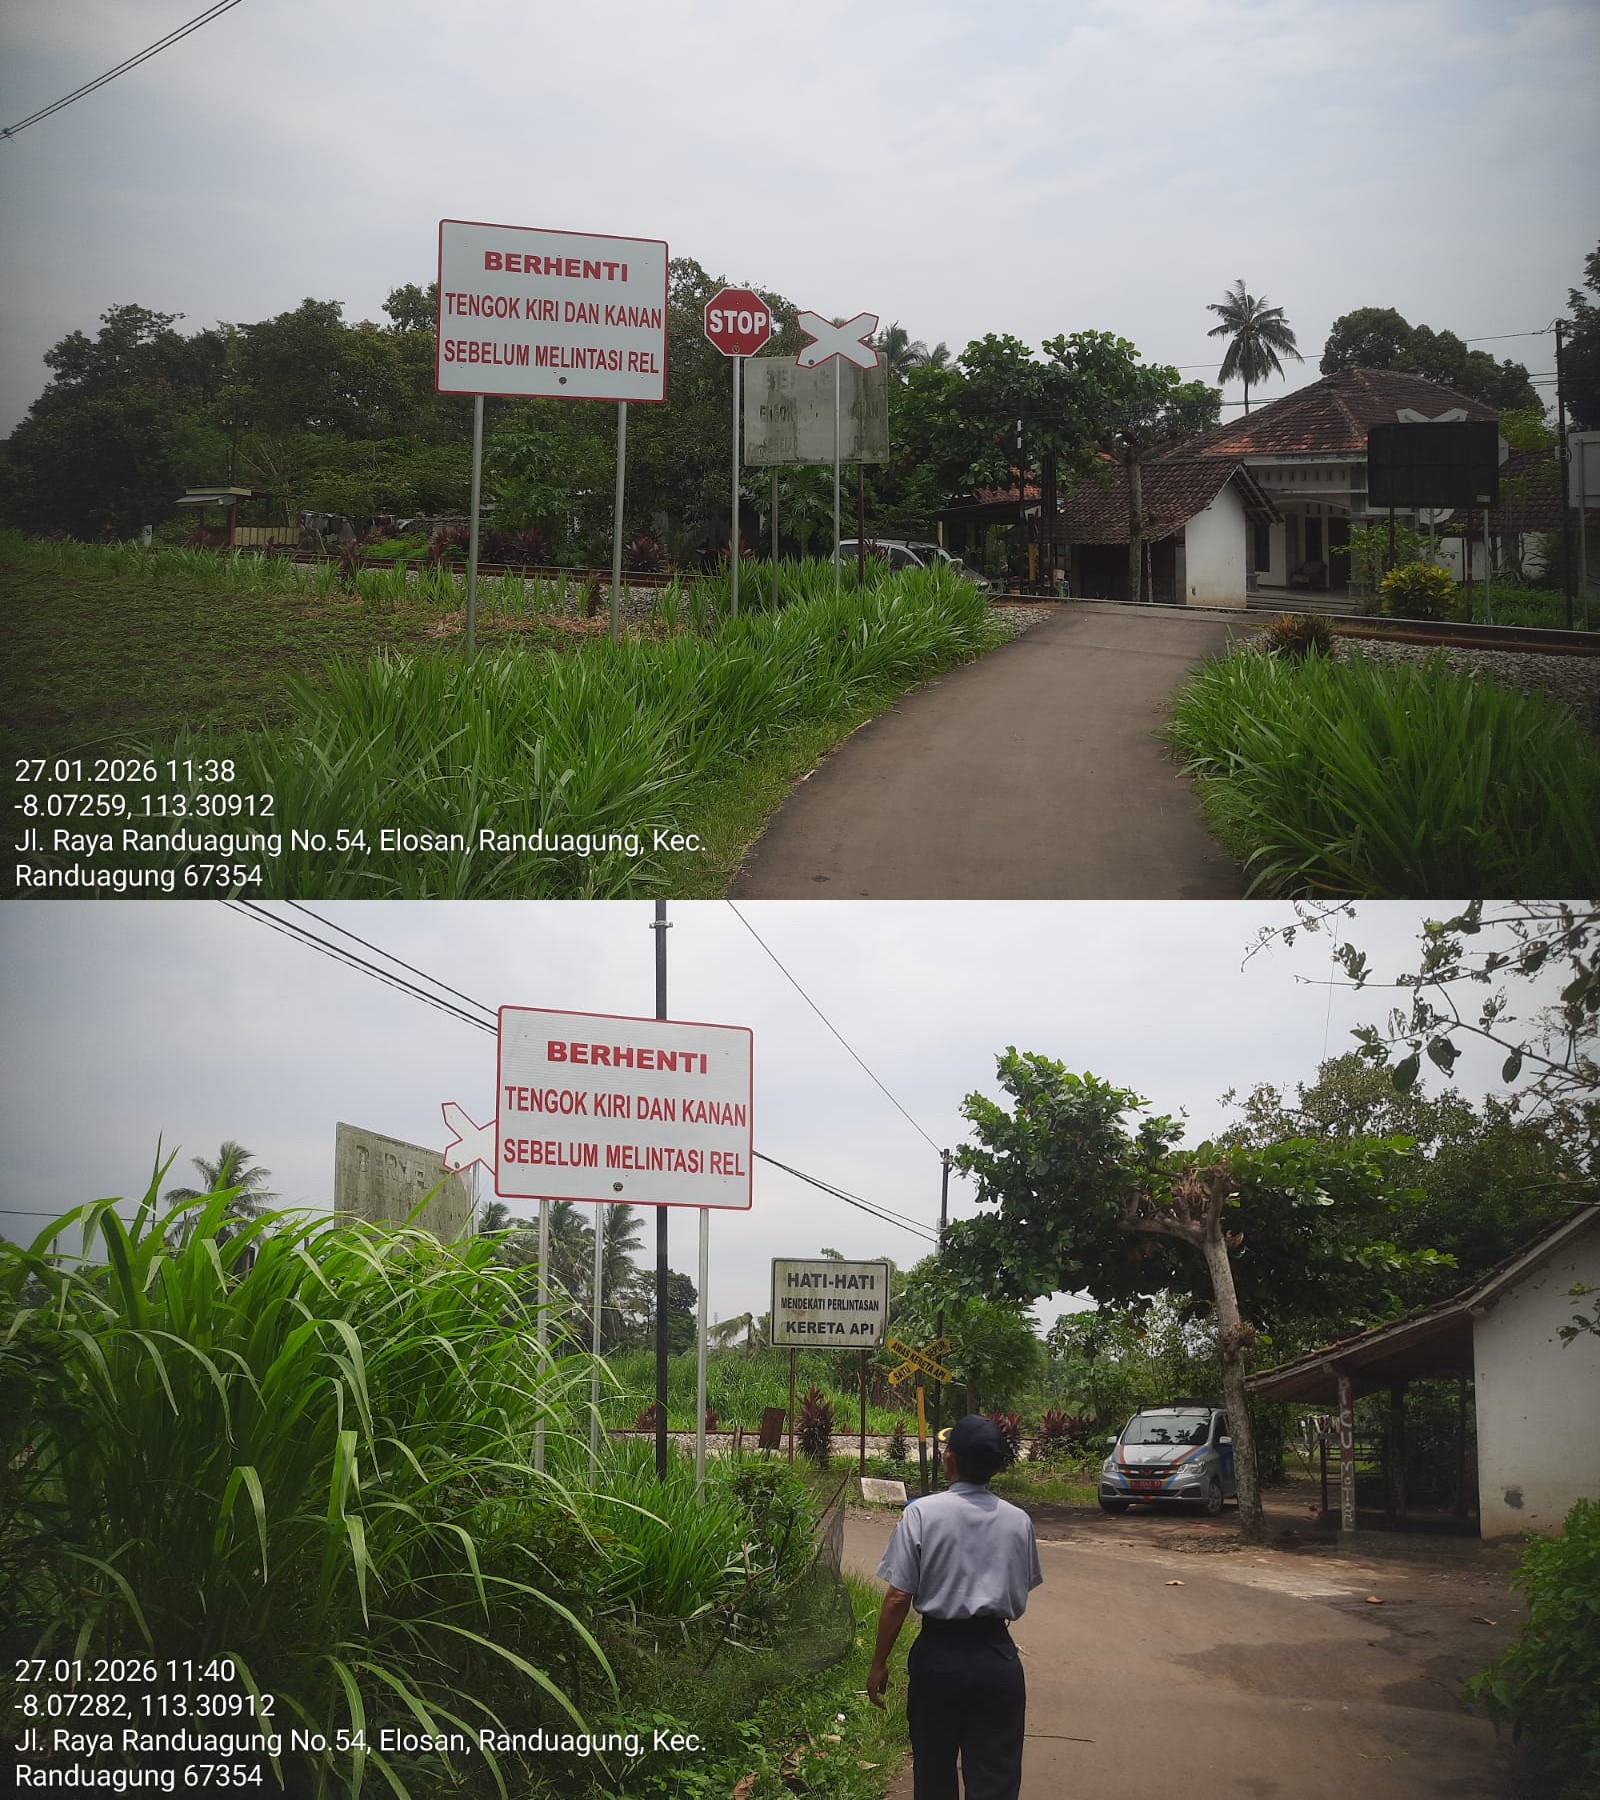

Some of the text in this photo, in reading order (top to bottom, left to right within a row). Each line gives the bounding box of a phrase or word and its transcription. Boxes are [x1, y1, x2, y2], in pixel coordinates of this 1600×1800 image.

[484, 250, 628, 282] BERHENTI
[445, 292, 662, 329] TENGOK KIRI DAN KANAN
[709, 309, 767, 335] STOP
[444, 339, 659, 374] SEBELUM MELINTASI REL
[547, 1040, 708, 1074] BERHENTI
[504, 1086, 746, 1127] TENGOK KIRI DAN KANAN
[503, 1138, 598, 1168] SEBELUM
[605, 1144, 704, 1174] MELINTASI
[709, 1151, 746, 1177] REL
[787, 1272, 875, 1290] HATI-HATI
[780, 1297, 879, 1311] MENDEKATI PERLINTASAN
[786, 1321, 875, 1335] KERETA API
